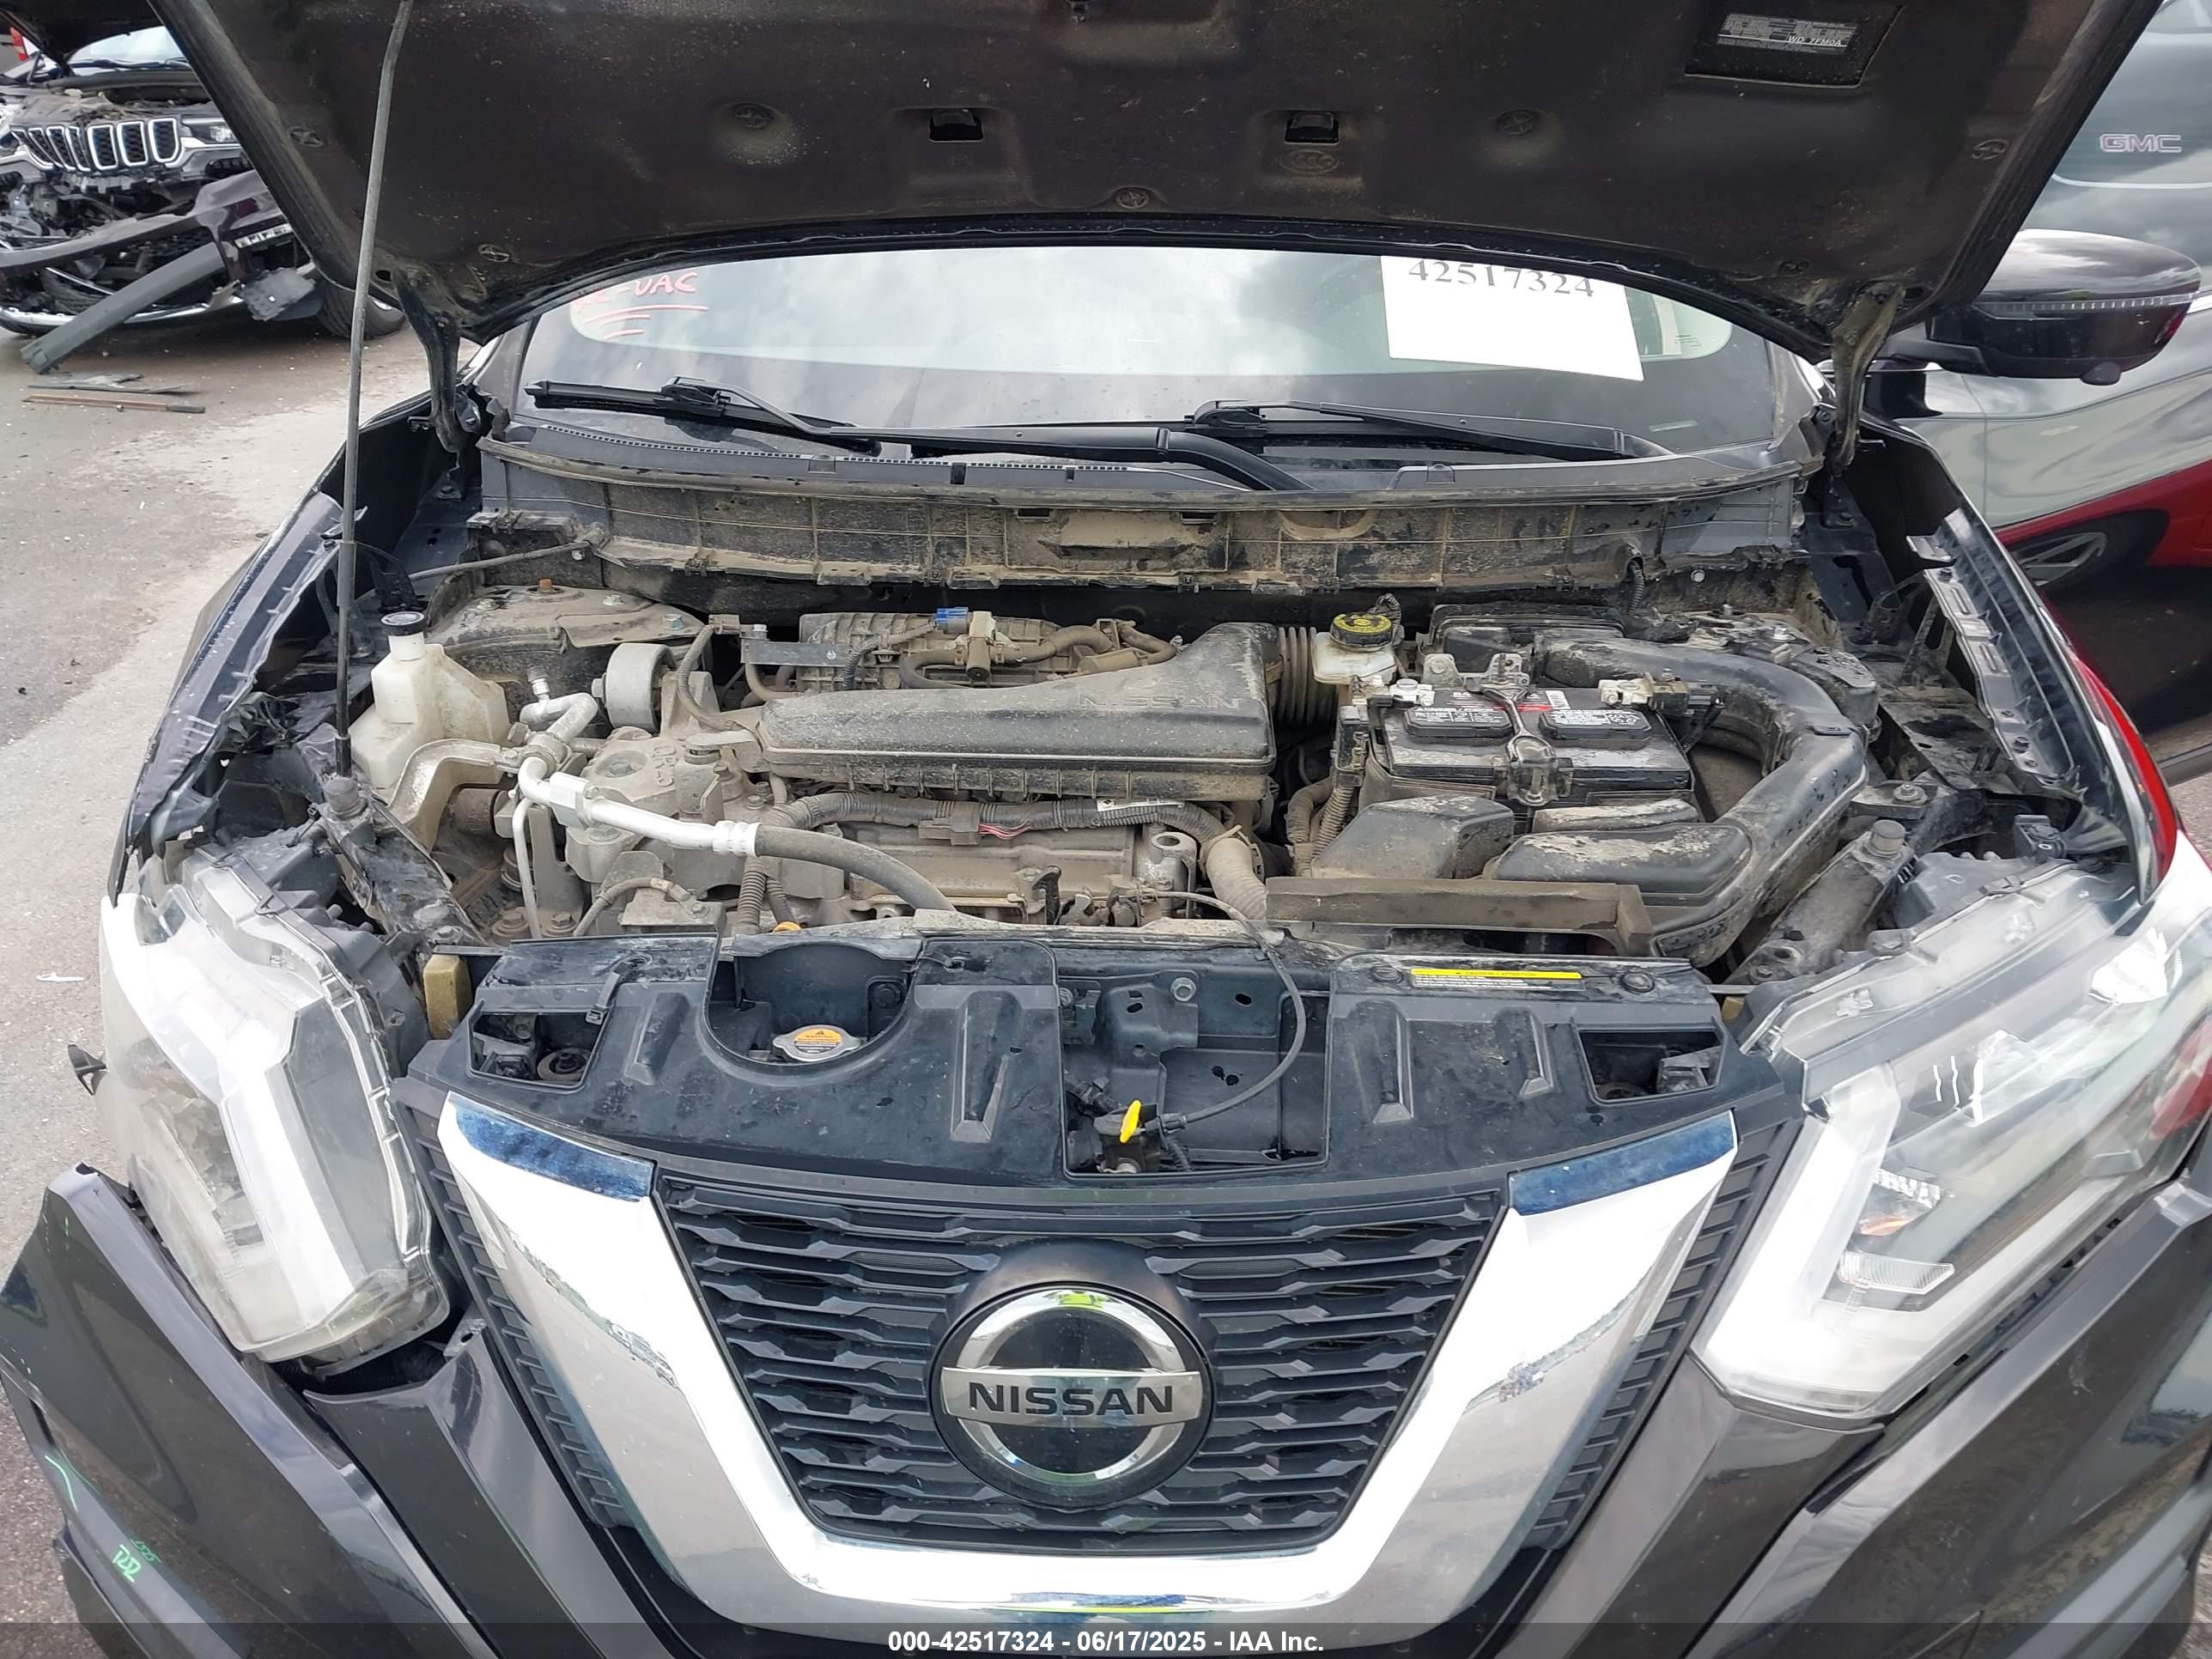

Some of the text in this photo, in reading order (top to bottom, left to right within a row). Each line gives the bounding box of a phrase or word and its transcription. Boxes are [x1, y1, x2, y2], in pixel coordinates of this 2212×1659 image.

[2100, 133, 2182, 153] GMC
[1408, 259, 1595, 297] 42517324
[969, 1382, 1173, 1416] NISSAN
